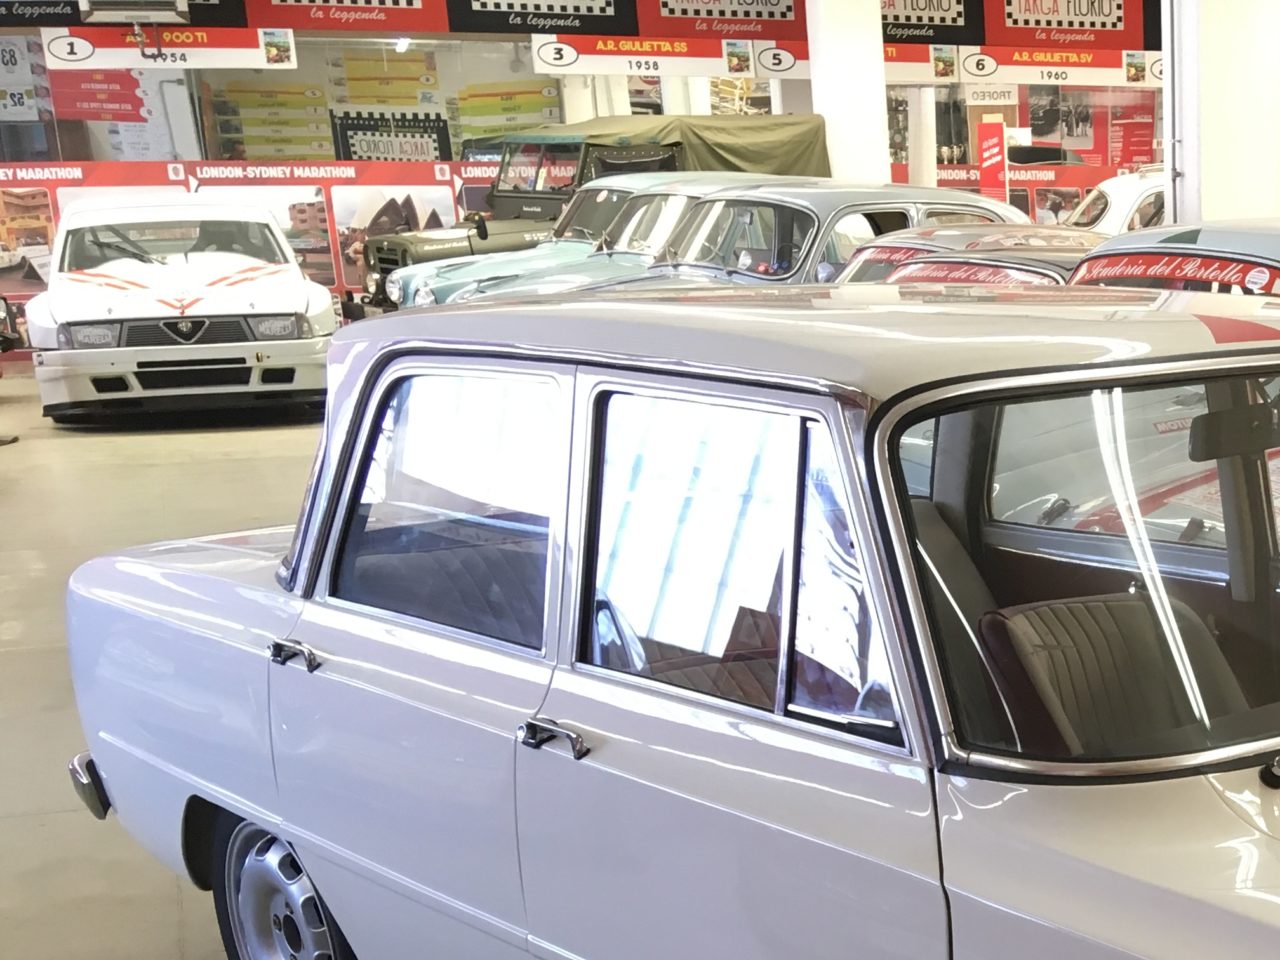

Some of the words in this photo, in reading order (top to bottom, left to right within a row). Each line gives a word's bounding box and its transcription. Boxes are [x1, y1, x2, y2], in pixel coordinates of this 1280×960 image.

[12, 3, 73, 16] leggenda
[310, 7, 325, 18] la
[329, 8, 387, 22] leggenda
[1018, 0, 1059, 16] TARGA
[1066, 0, 1112, 17] FLORIO
[508, 13, 523, 25] la
[527, 14, 581, 29] leggenda
[695, 20, 708, 30] la
[712, 21, 763, 34] leggenda
[159, 32, 193, 43] 900
[194, 32, 208, 43] TI
[886, 24, 935, 39] leggenda
[1035, 30, 1047, 40] la
[1050, 30, 1096, 43] leggenda
[66, 41, 78, 56] 1
[596, 40, 618, 51] A.R.
[618, 41, 673, 52] GIULIETTA
[673, 42, 688, 52] SS
[886, 47, 896, 58] TI
[552, 47, 564, 61] 3
[771, 53, 782, 66] 5
[1033, 52, 1079, 63] GIULIETTA
[628, 60, 659, 71] 1958
[975, 58, 986, 72] 6
[1040, 70, 1068, 81] 1960
[16, 167, 83, 180] MARATHON
[195, 166, 292, 179] LONDON-SYDNEY
[293, 166, 356, 179] MARATHON
[1007, 170, 1056, 181] MARATHON
[1147, 258, 1173, 277] del
[1177, 257, 1243, 283] Portello
[1156, 417, 1192, 432] MOTU
